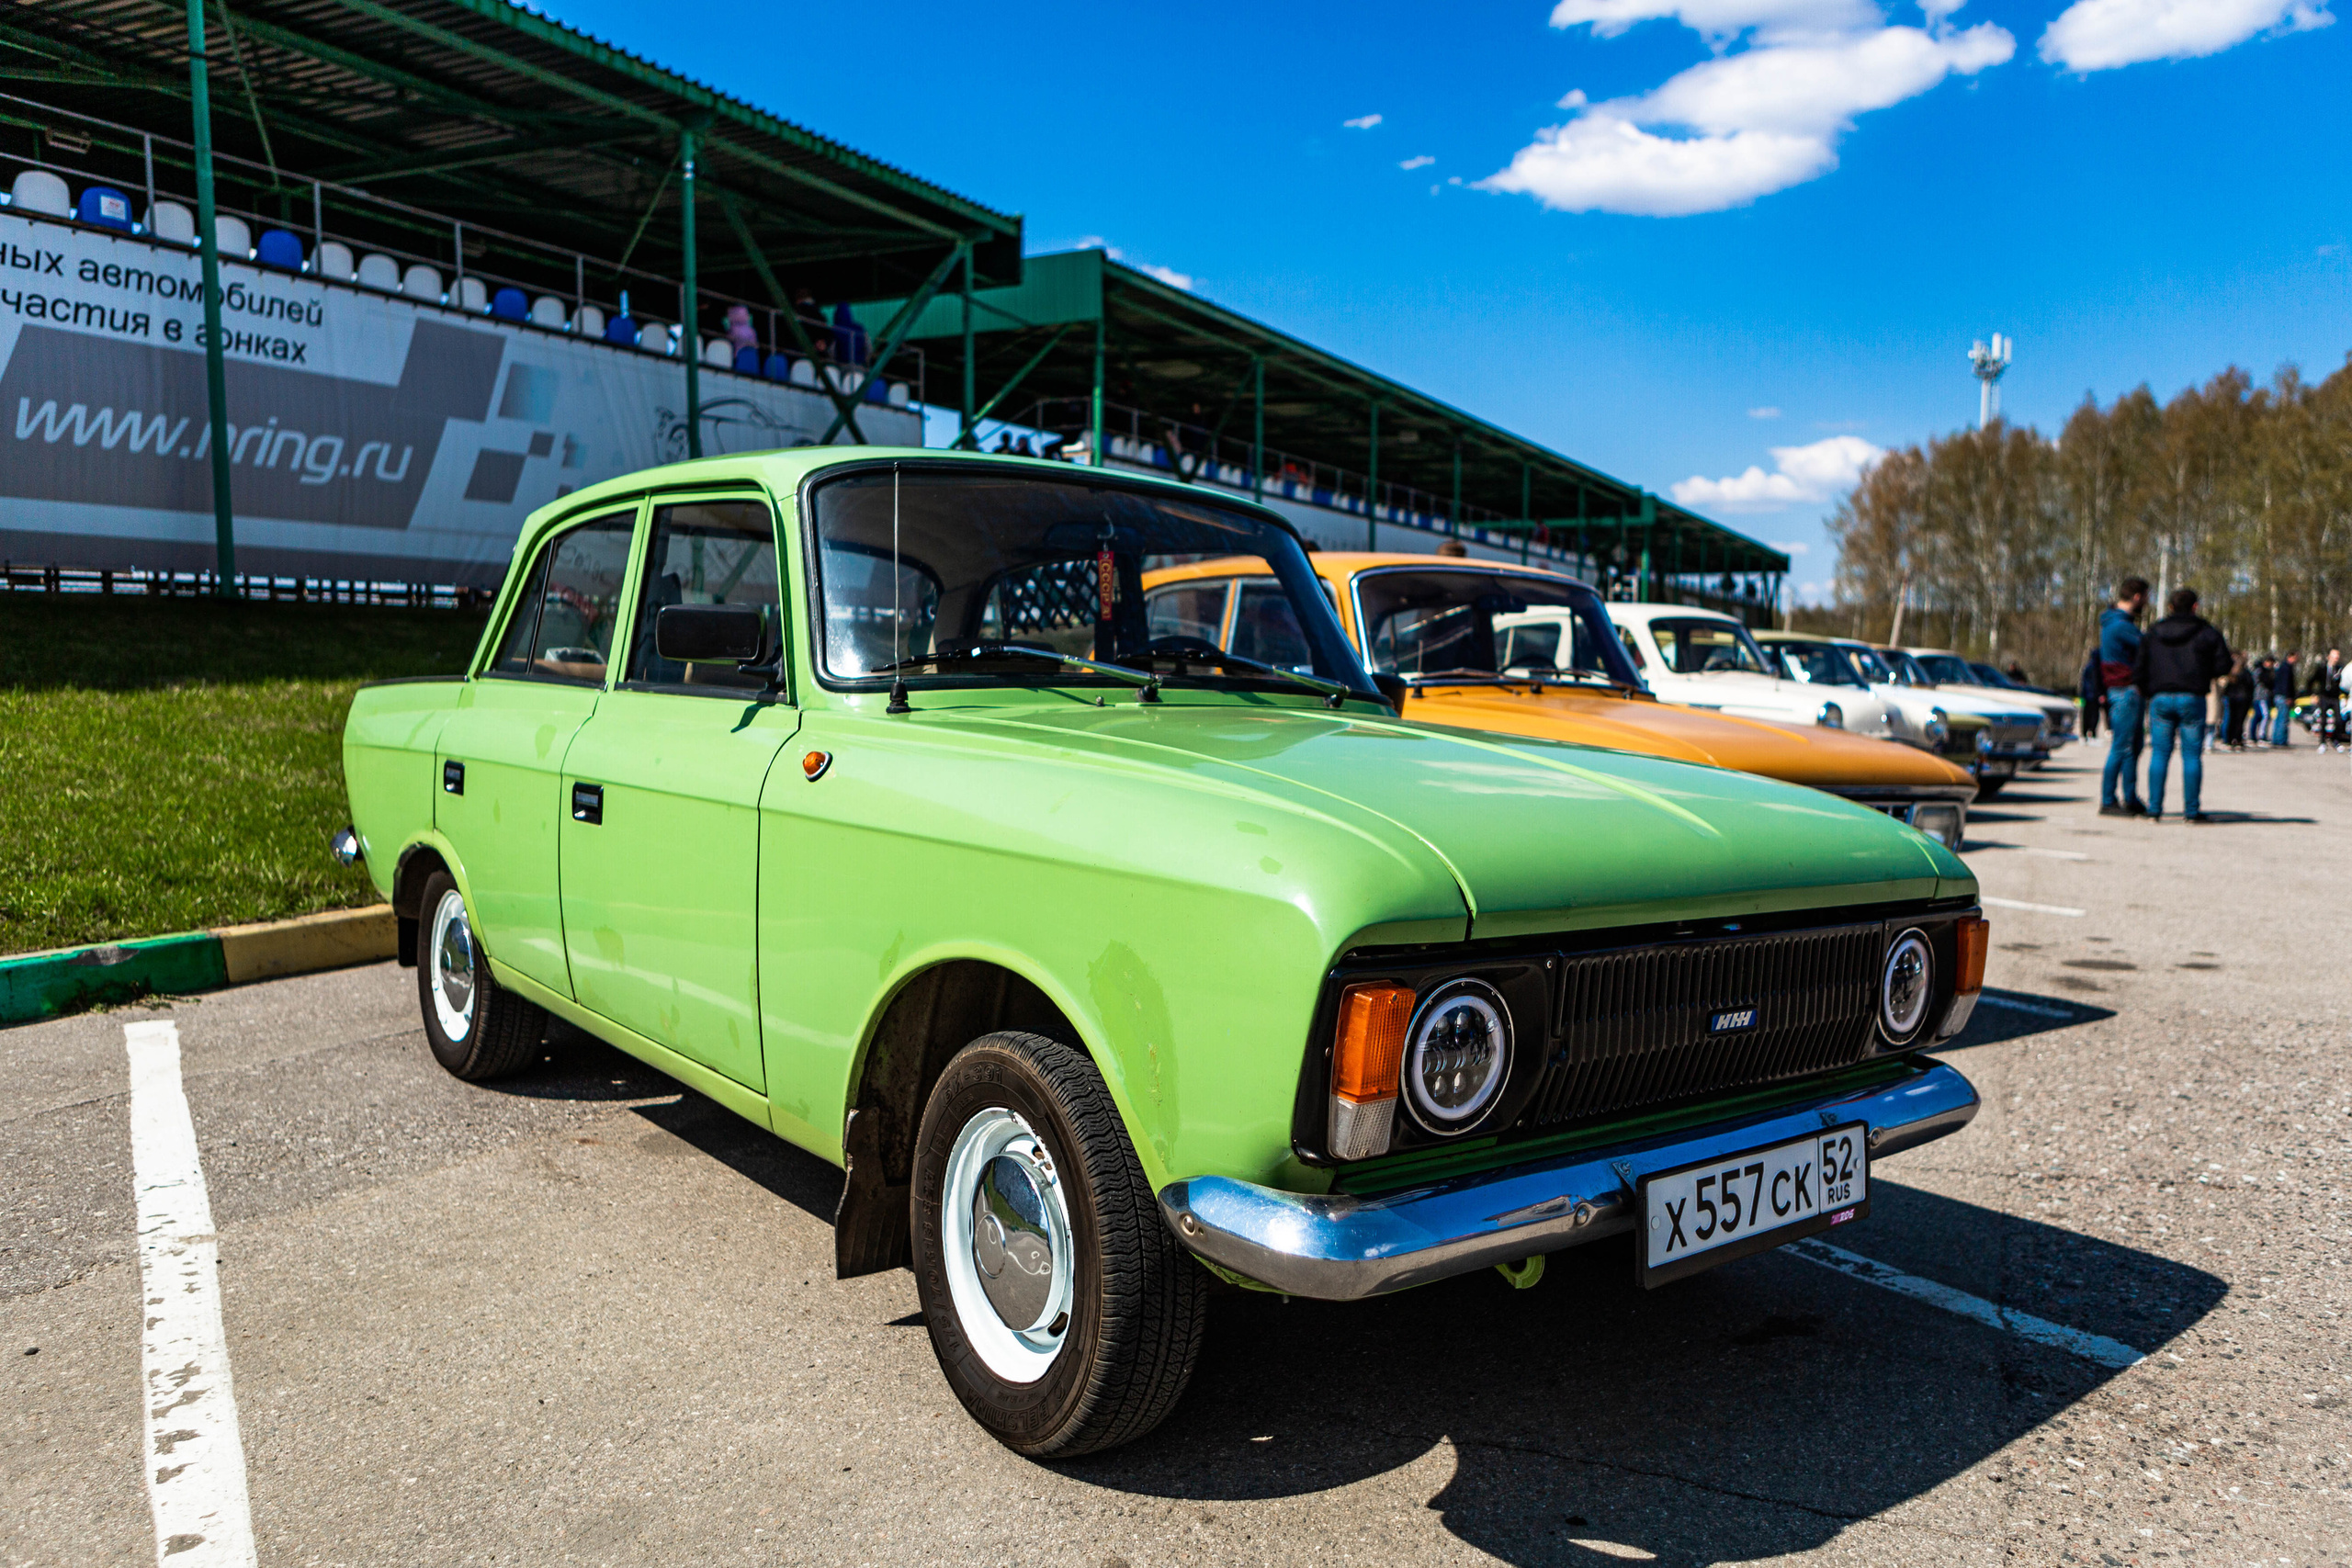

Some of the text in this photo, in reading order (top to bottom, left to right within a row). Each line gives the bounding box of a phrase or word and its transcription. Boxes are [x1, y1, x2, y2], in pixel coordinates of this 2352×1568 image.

[163, 318, 183, 344] в
[1822, 1136, 1853, 1185] 52
[1827, 1182, 1851, 1205] RUS
